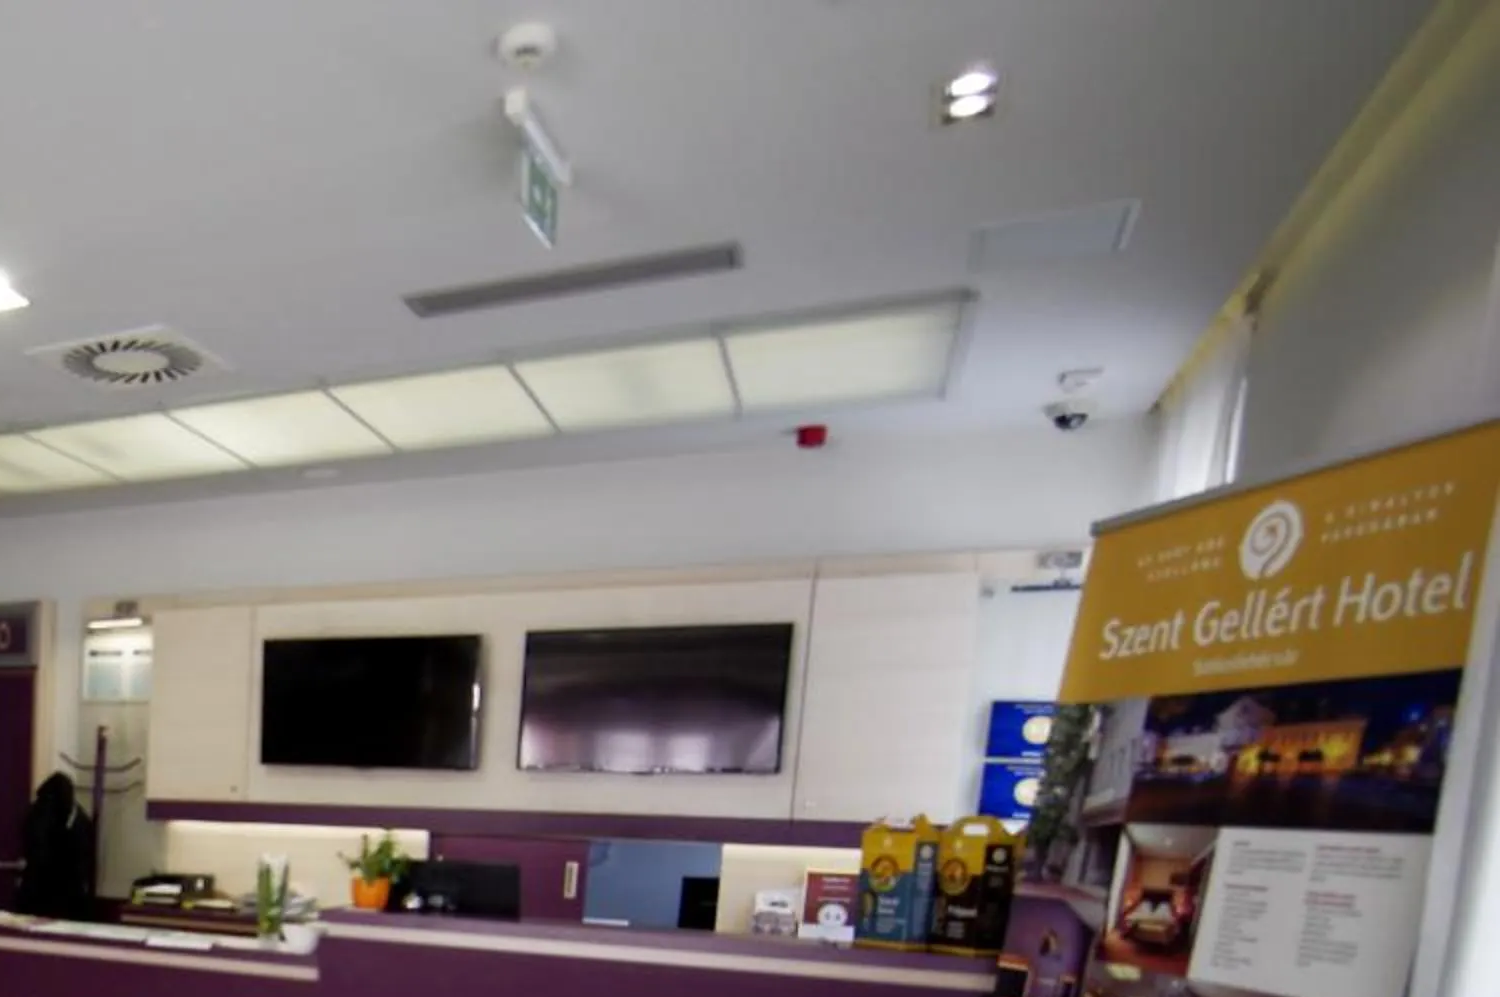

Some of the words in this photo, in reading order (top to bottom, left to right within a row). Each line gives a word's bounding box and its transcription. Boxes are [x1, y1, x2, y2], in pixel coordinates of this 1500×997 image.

[1099, 609, 1186, 661] Szent
[1193, 587, 1325, 648] Gellért
[1333, 551, 1476, 628] Hotel
